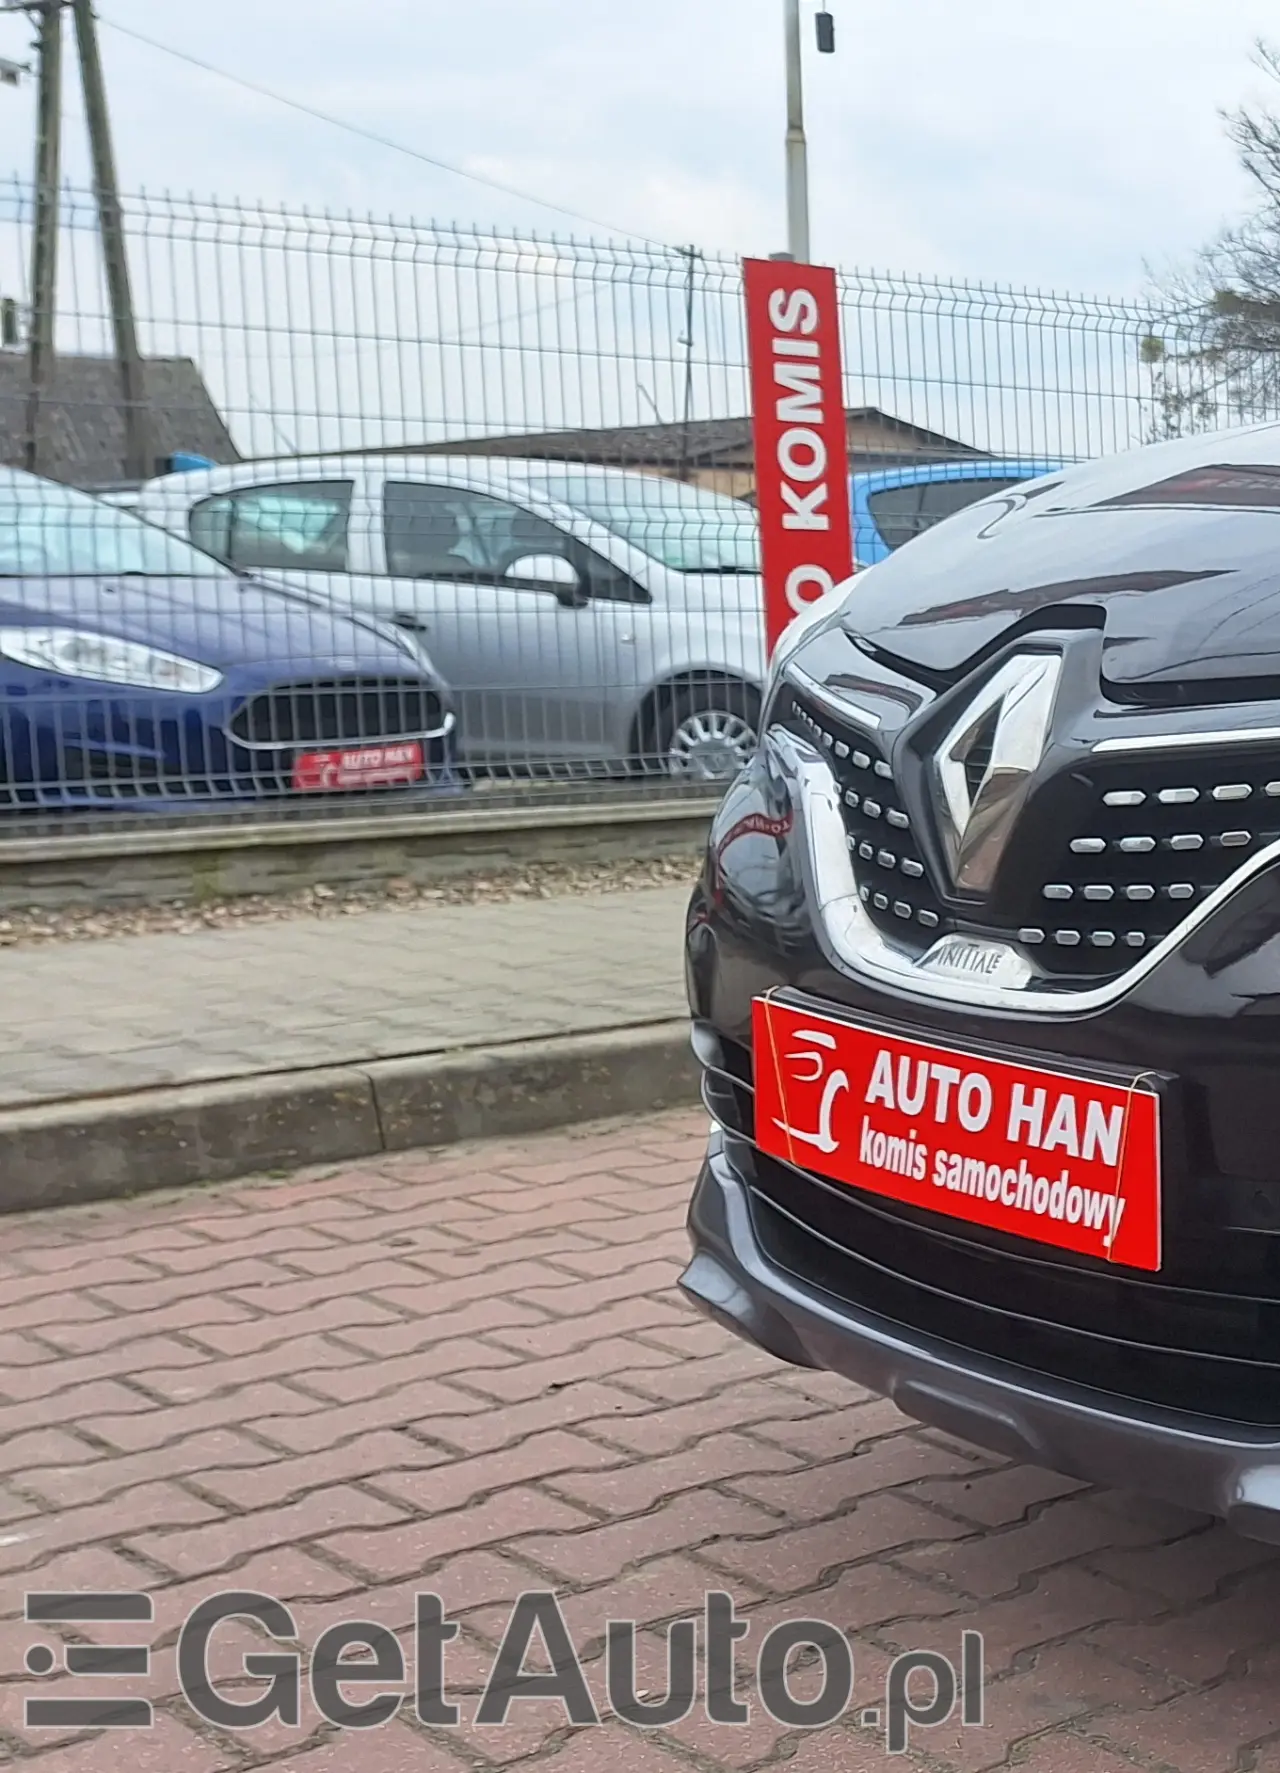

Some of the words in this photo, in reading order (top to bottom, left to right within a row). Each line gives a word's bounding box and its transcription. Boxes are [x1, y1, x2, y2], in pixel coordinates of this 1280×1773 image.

[768, 287, 830, 531] KOMIS
[937, 942, 1002, 975] INITIALE
[864, 1049, 993, 1133] AUTO
[1006, 1082, 1125, 1167] HAN
[858, 1114, 928, 1181] komis
[931, 1148, 1127, 1248] samochodowy
